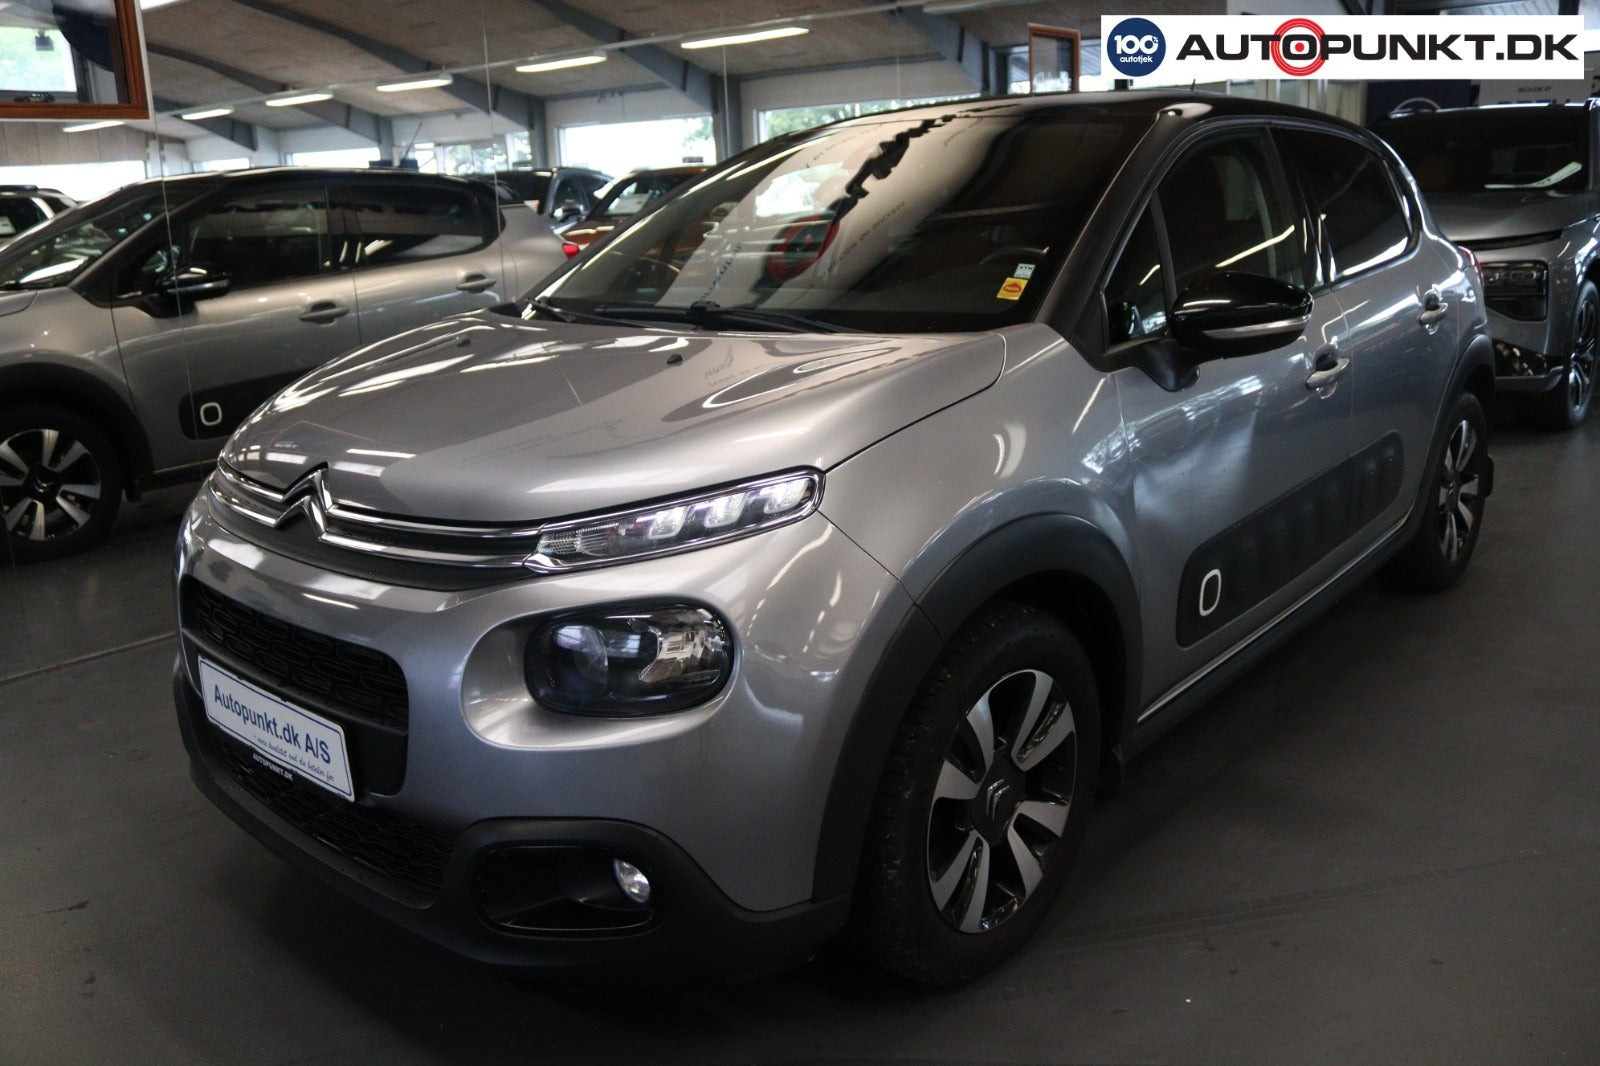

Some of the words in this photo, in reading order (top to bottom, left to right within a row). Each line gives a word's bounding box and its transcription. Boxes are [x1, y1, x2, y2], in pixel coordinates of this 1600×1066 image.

[214, 684, 301, 749] Autopunkt.dk
[305, 733, 331, 764] A/S
[252, 753, 293, 781] AUTOPUNKT.DK
